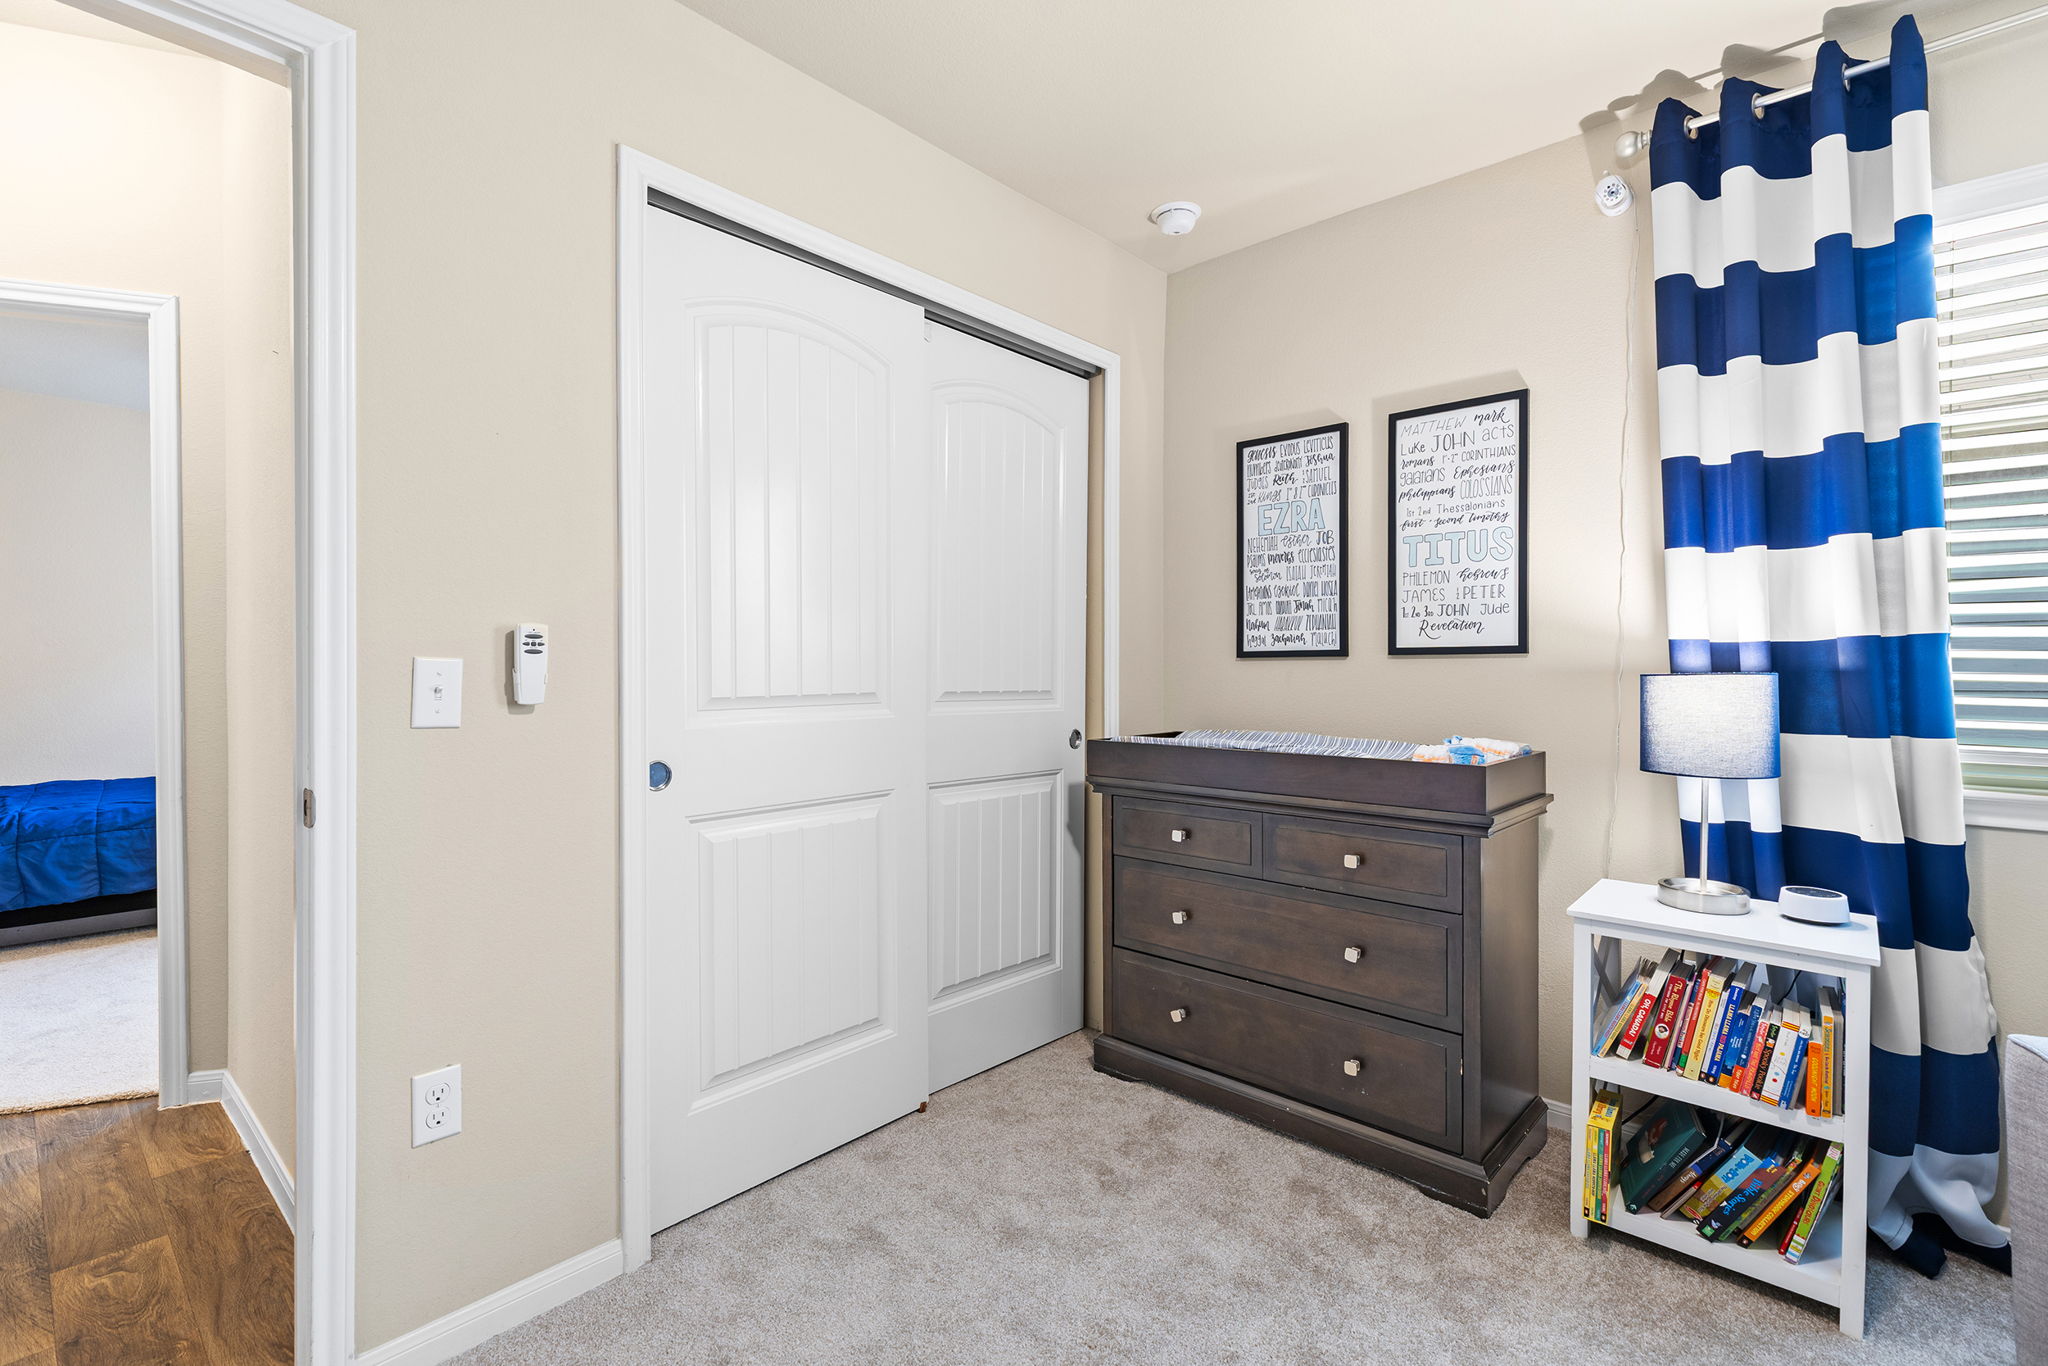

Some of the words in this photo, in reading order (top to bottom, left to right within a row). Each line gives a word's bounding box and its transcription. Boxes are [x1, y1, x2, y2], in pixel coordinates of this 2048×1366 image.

[1401, 416, 1466, 437] MATTHEW
[1431, 430, 1475, 453] JOHN
[1462, 444, 1516, 462] CORINTHIANS
[1461, 475, 1512, 499] COLOSSIANS
[1258, 498, 1325, 536] EZRA
[1437, 499, 1505, 514] Thessalonians
[1402, 526, 1514, 568] TITUS
[1403, 570, 1451, 586] PHILEMON
[1402, 588, 1445, 603] JAMES
[1463, 584, 1506, 600] PETER
[1437, 603, 1470, 617] JOHN
[1480, 603, 1510, 615] Jude
[1419, 618, 1485, 640] Revelation
[1725, 1003, 1735, 1019] LLAMA
[1626, 1007, 1648, 1037] CANADA!
[1721, 1018, 1731, 1035] LLAMA
[1741, 1176, 1764, 1200] Bible
[1721, 1190, 1747, 1219] Stories
